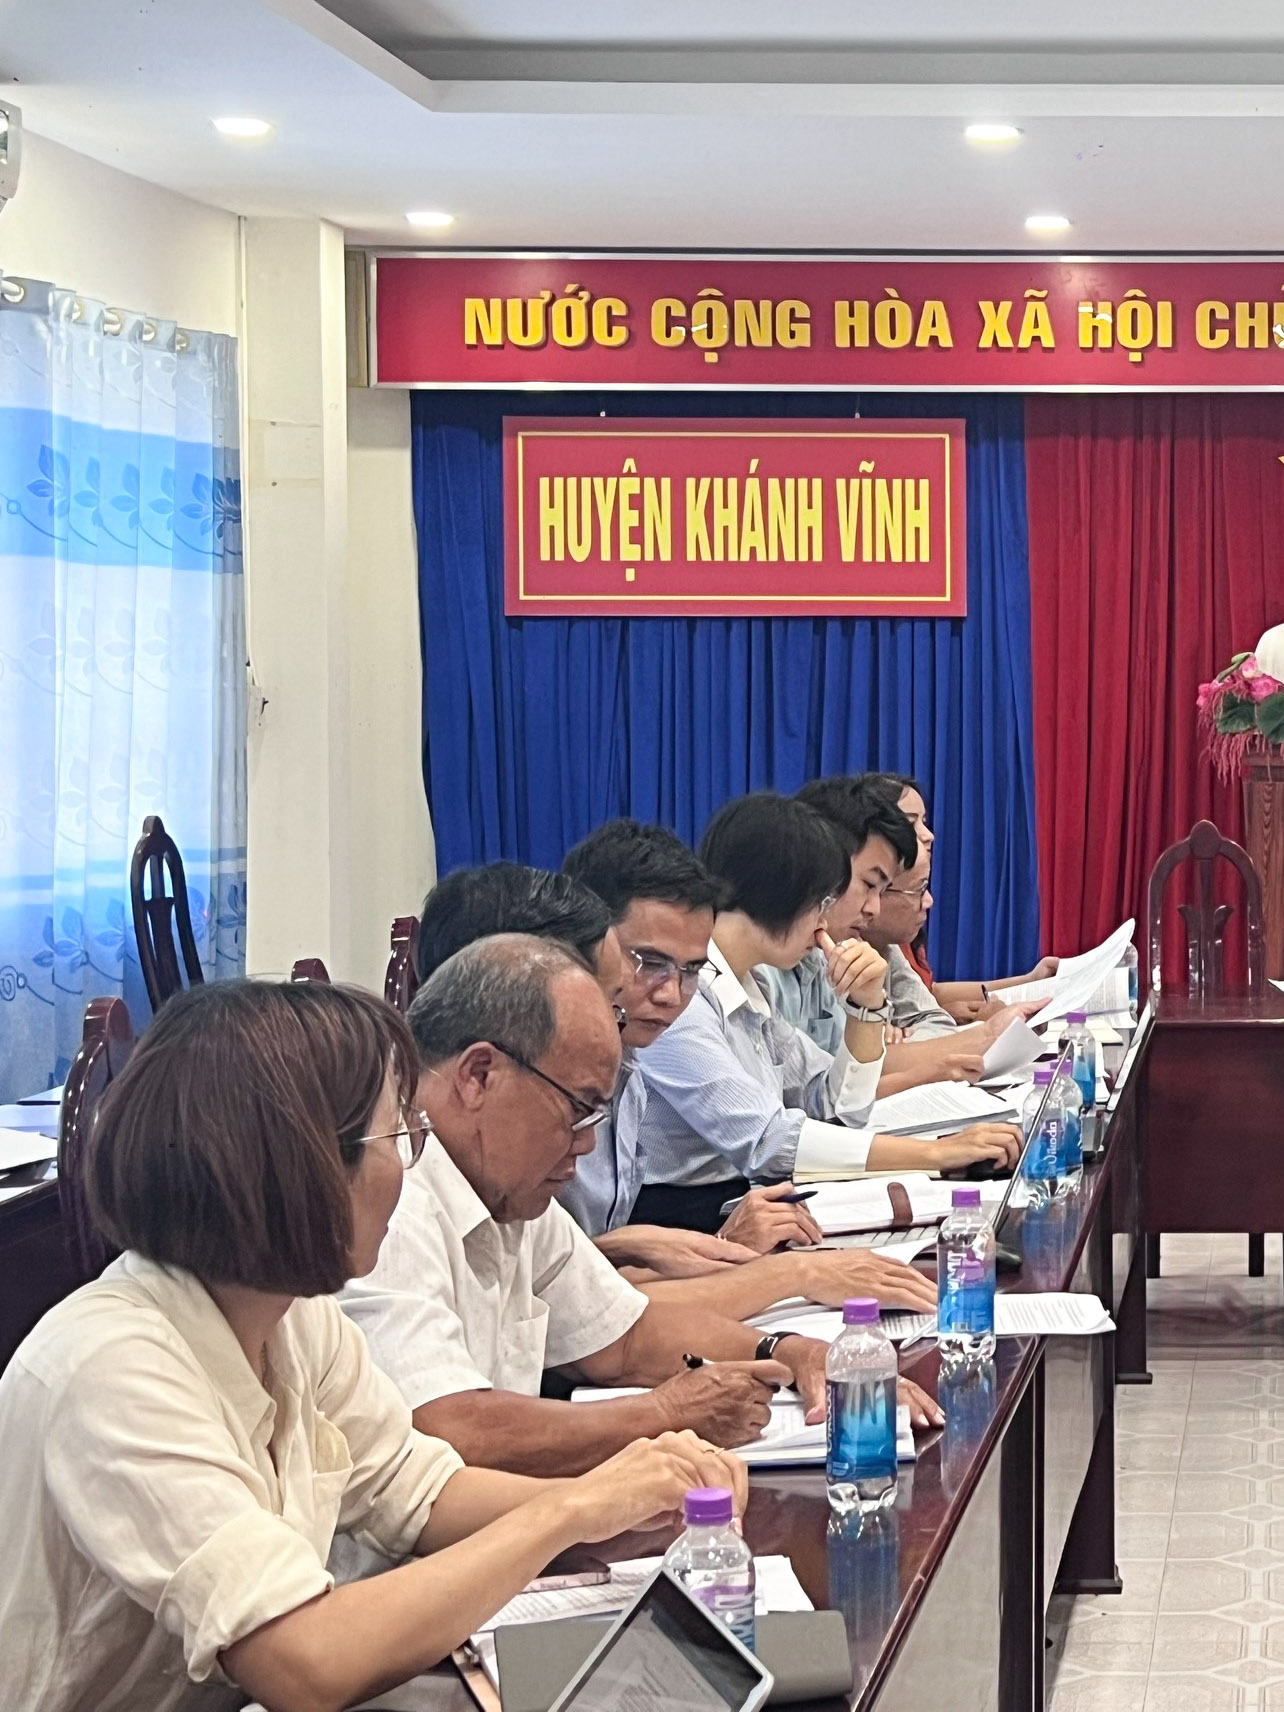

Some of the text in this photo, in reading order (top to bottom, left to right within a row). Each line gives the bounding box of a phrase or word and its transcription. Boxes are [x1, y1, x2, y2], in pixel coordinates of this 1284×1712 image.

[464, 283, 628, 348] NƯỚC
[651, 287, 811, 363] CỘNG
[835, 287, 953, 348] HÒA
[979, 289, 1056, 349] XÃ
[1078, 289, 1173, 362] HỘI
[539, 458, 930, 581] HUYỆN KHÁNH VĨNH
